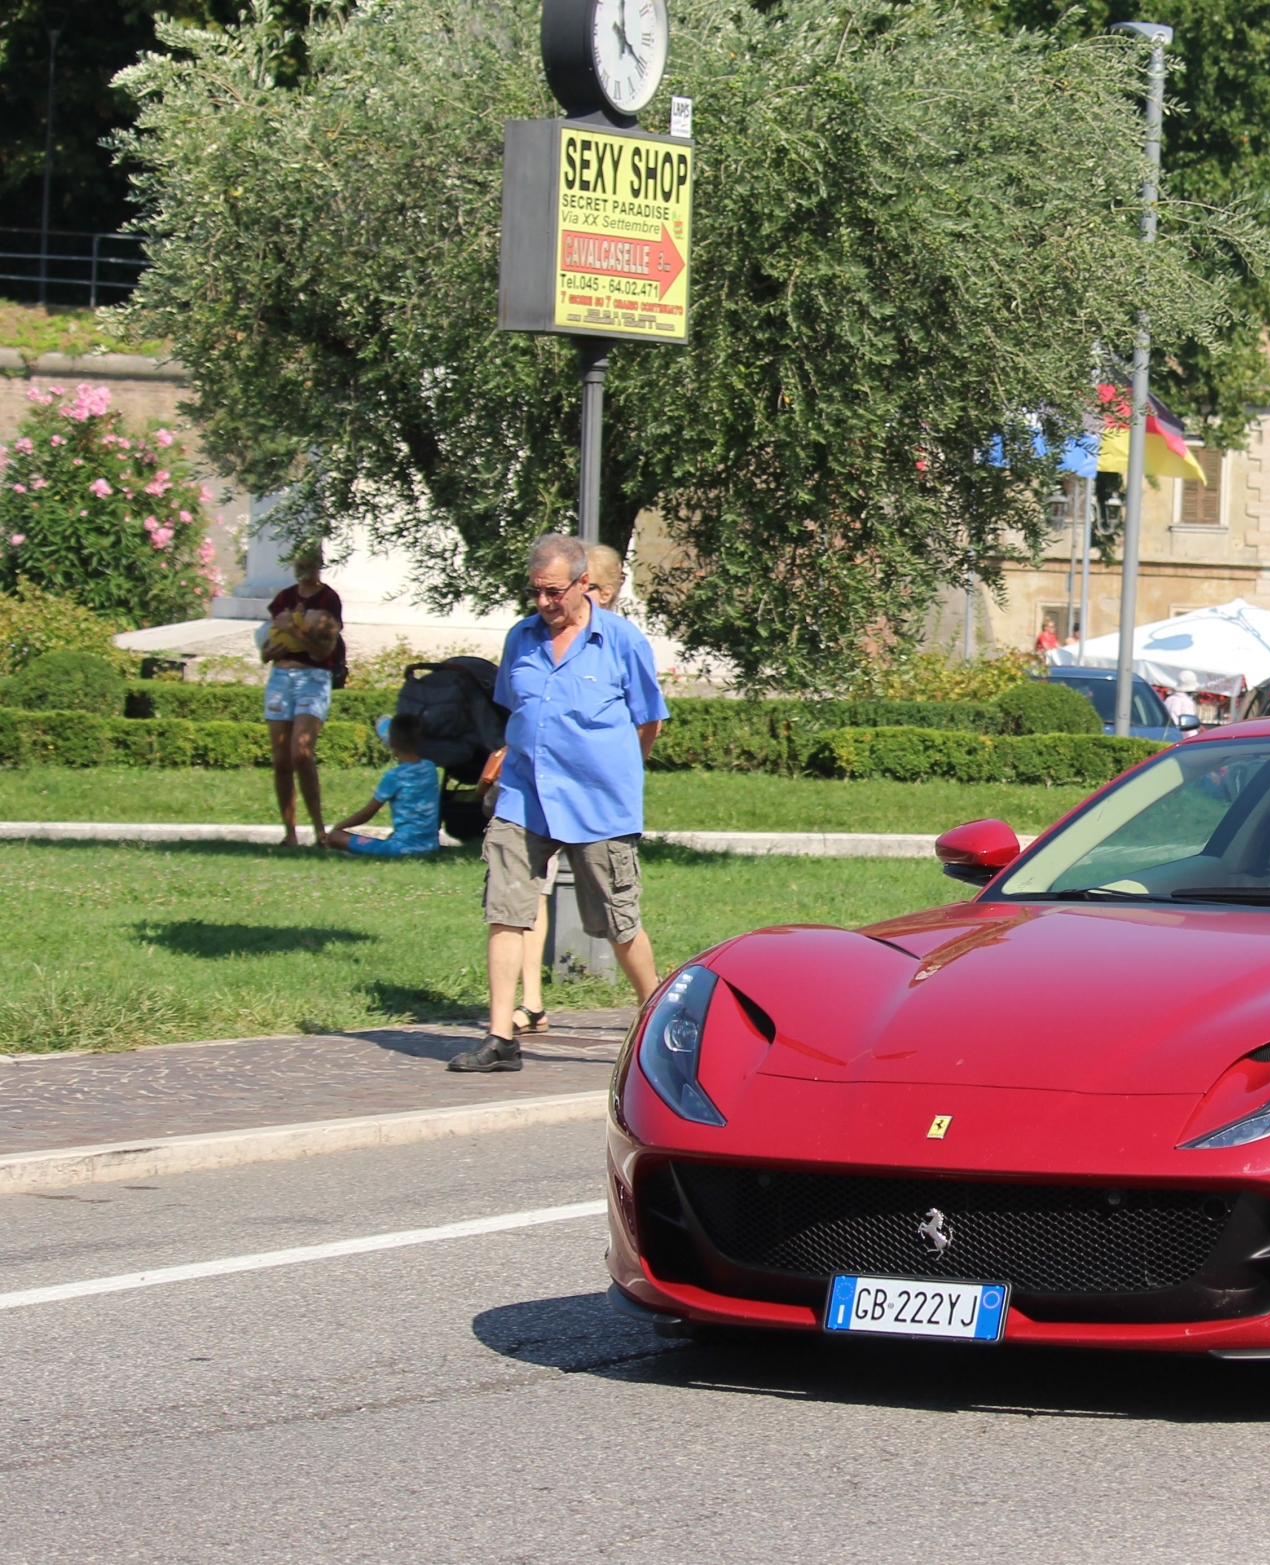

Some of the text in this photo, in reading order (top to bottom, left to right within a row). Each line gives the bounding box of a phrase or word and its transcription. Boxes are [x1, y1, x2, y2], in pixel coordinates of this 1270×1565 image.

[564, 137, 688, 204] SEXY SHOP
[562, 194, 670, 221] SECRET PARADISE
[561, 209, 661, 235] Via XX Settembre
[565, 236, 650, 274] CAVALCASELLE
[560, 272, 599, 292] Tel.045
[608, 278, 659, 299] 64.02.471
